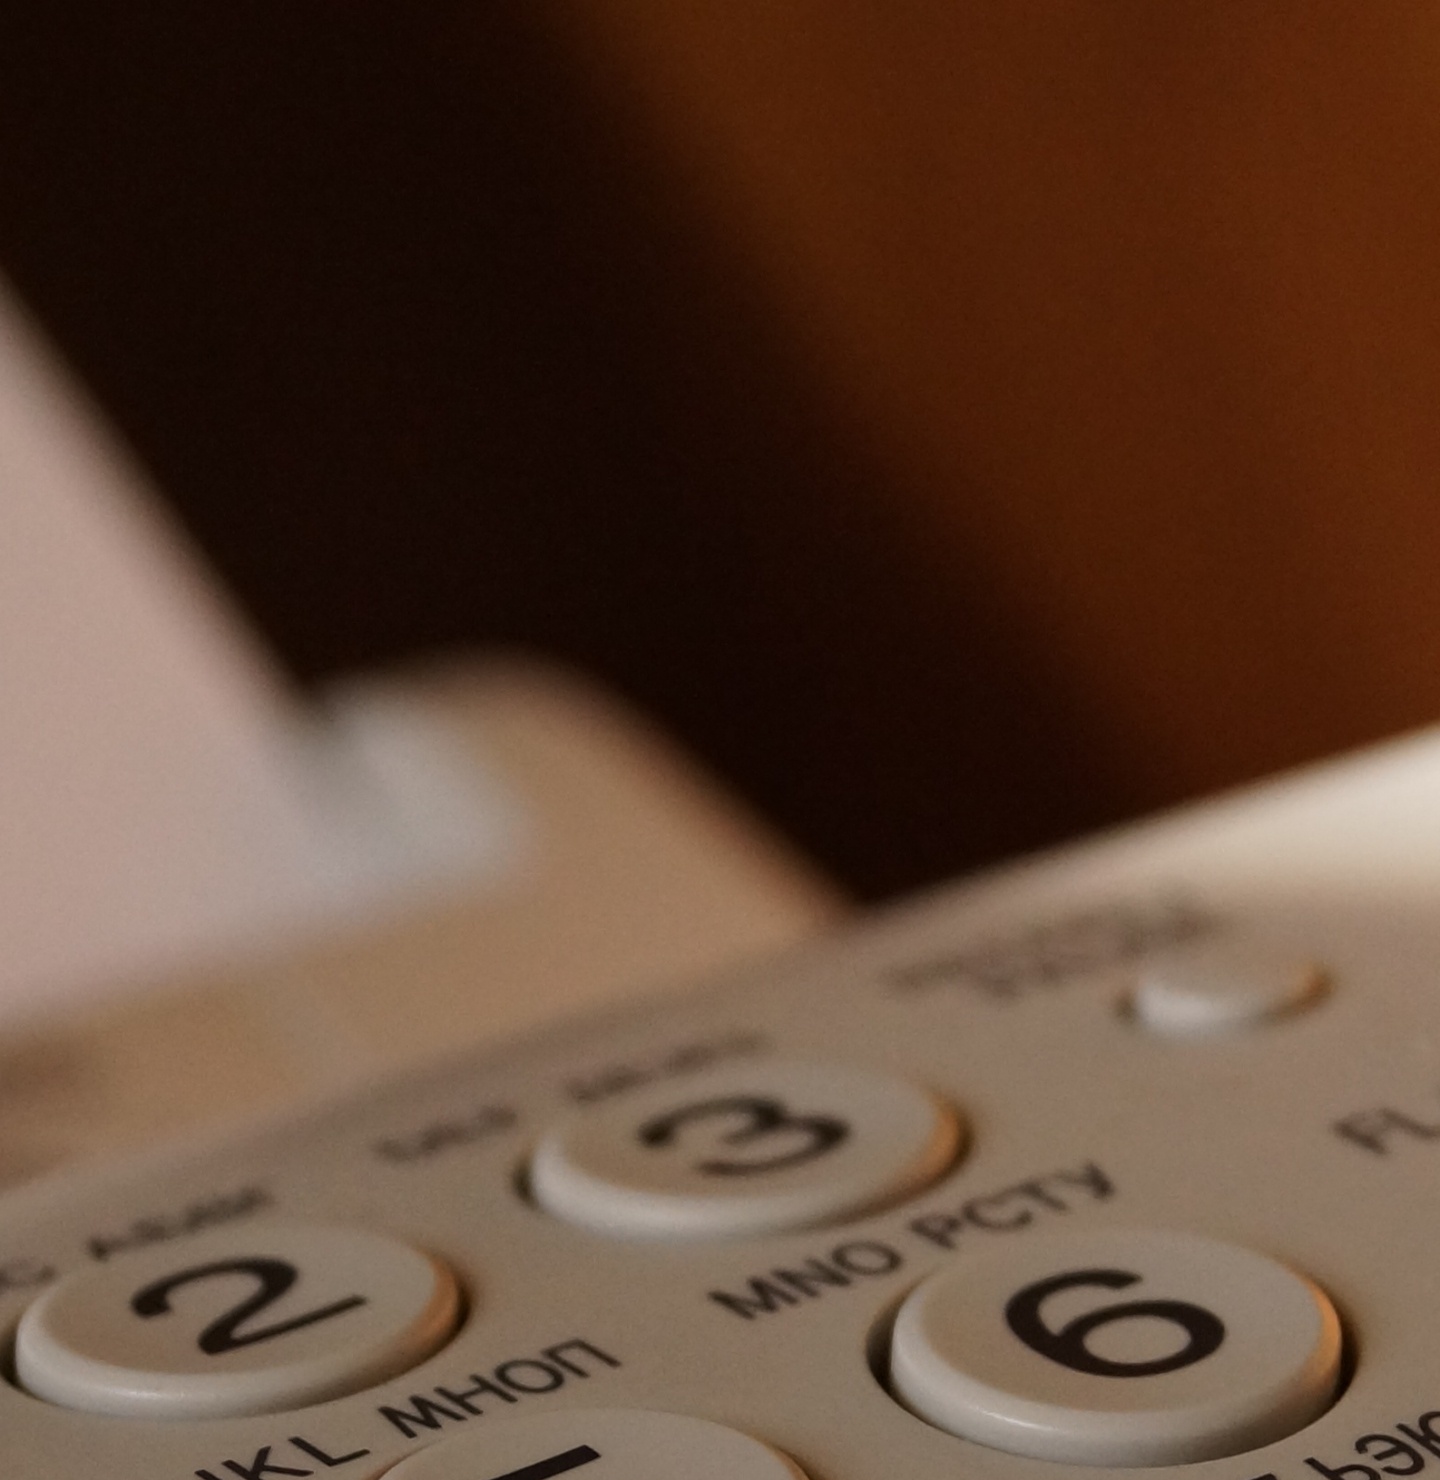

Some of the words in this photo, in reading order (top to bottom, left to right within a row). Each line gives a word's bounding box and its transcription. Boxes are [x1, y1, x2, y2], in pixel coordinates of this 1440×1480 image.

[640, 1096, 850, 1178] 3
[708, 1240, 902, 1321] MNO
[910, 1162, 1118, 1250] РСТУ
[130, 1255, 368, 1357] 2
[1005, 1268, 1226, 1378] 6
[377, 1338, 623, 1440] МНОП
